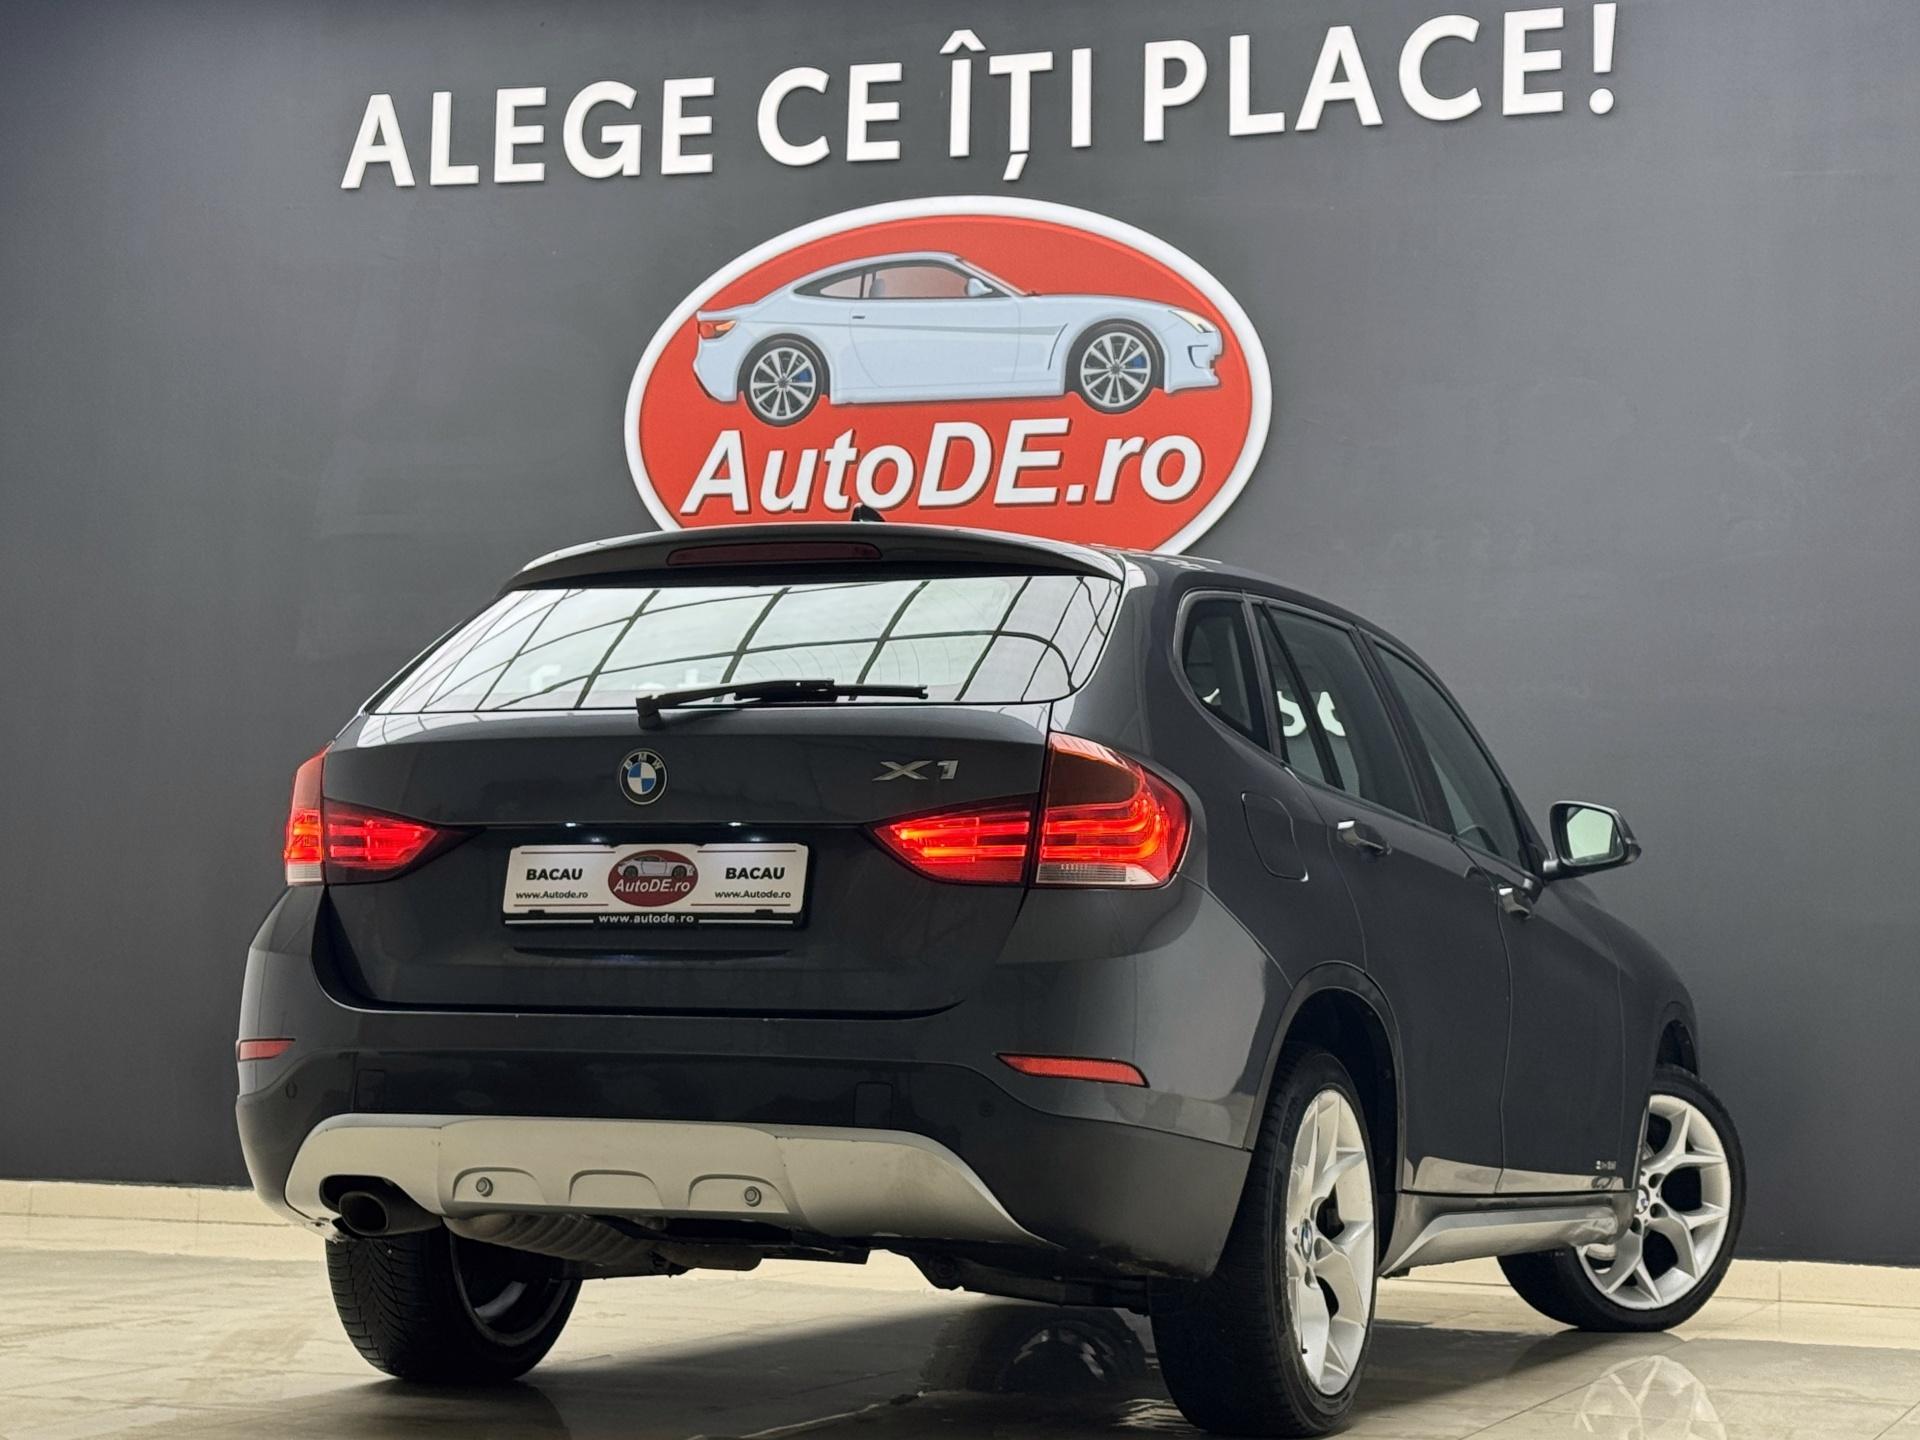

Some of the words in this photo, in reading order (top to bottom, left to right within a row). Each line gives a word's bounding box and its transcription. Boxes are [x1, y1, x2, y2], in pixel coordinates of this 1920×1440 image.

[341, 77, 714, 189] ALEGE
[757, 62, 903, 167] CE
[939, 28, 1094, 181] ÎȚI
[1143, 2, 1618, 142] PLACE!
[680, 417, 1205, 517] AutoDE.ro
[872, 760, 959, 781] X1
[526, 868, 583, 881] BACAU
[725, 867, 785, 880] BACAU
[612, 878, 691, 894] AutoDE.ro
[516, 890, 588, 899] www.Autode.ro
[714, 890, 791, 899] www.Autode.ro
[599, 914, 694, 924] www.autode.ro
